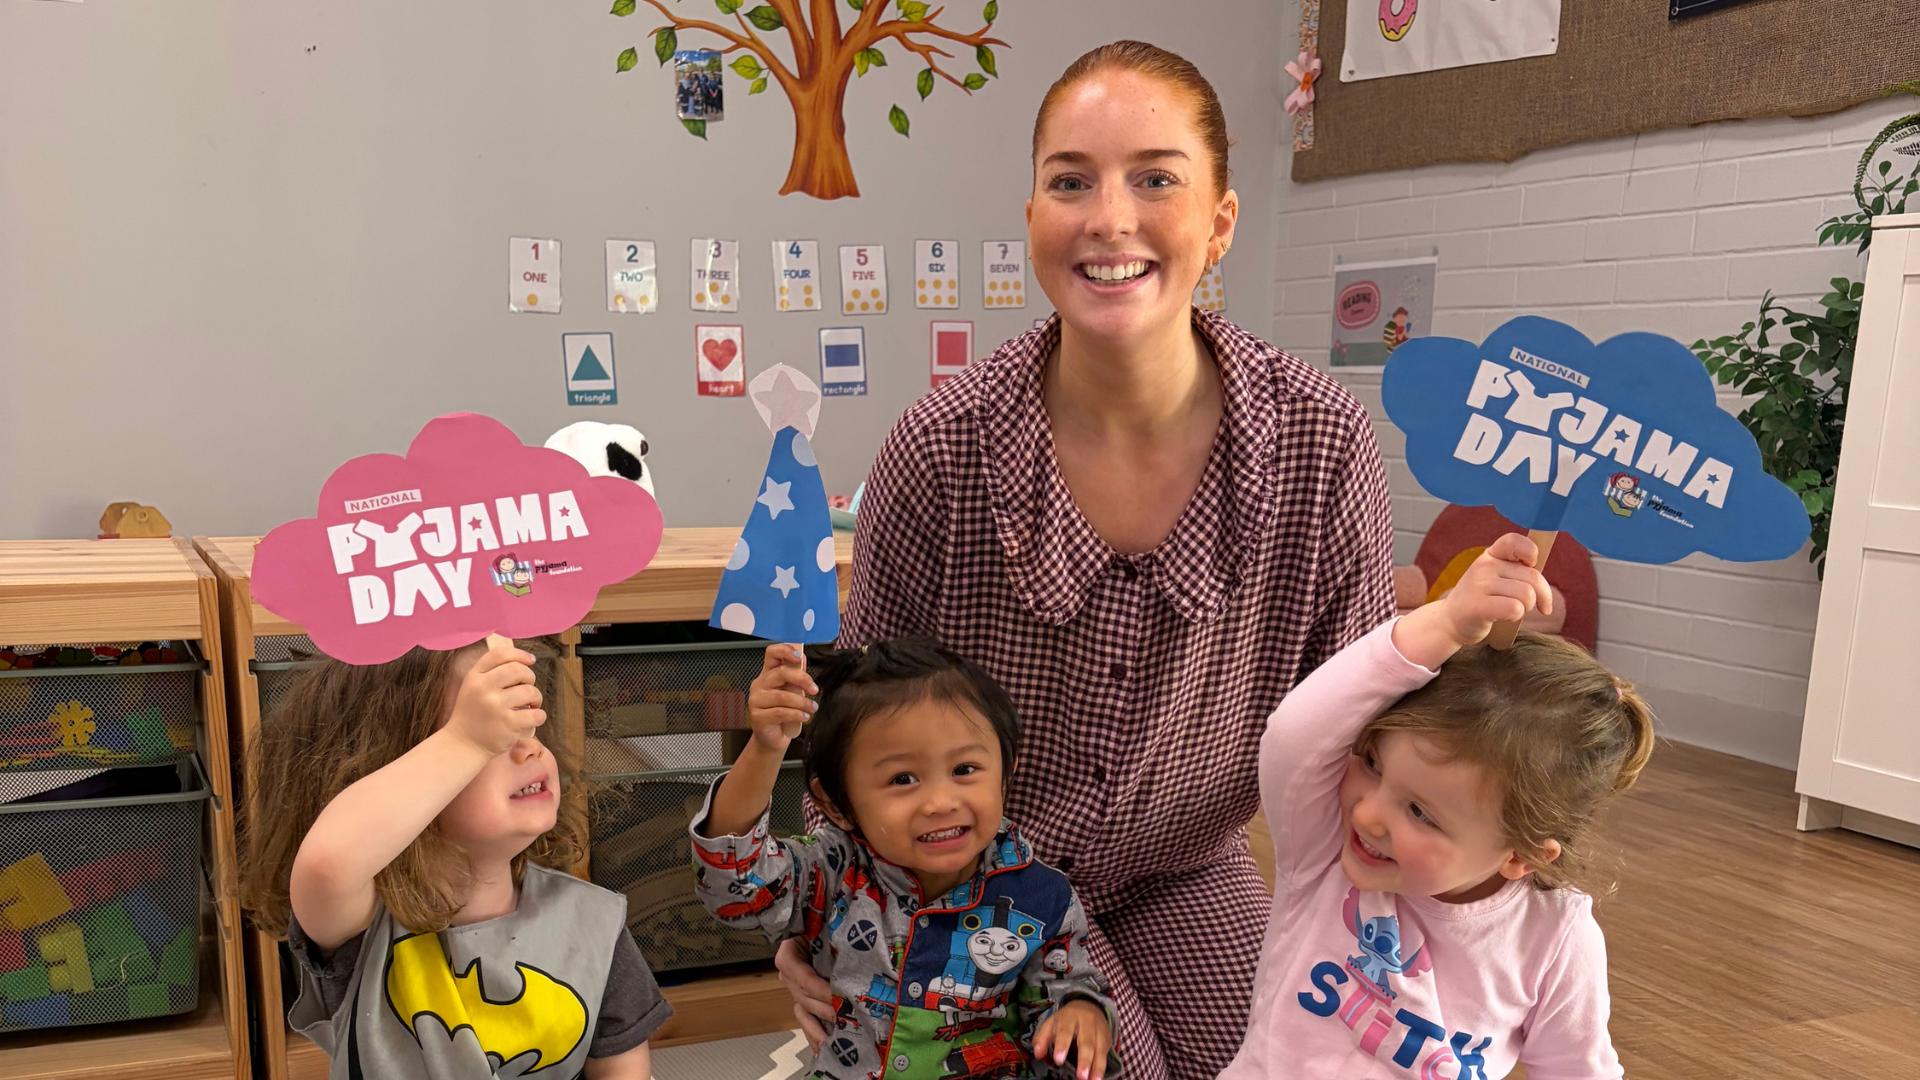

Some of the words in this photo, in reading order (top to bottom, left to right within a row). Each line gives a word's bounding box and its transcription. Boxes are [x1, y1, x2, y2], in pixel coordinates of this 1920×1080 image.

[531, 242, 540, 261] 1
[626, 244, 639, 263] 2
[711, 241, 722, 258] 3
[788, 241, 802, 259] 4
[856, 248, 868, 266] 5
[931, 241, 943, 258] 6
[997, 243, 1008, 260] 7
[696, 269, 731, 281] THREE
[783, 269, 811, 279] FOUR
[852, 271, 876, 281] FIVE
[928, 263, 945, 273] SIX
[989, 263, 1020, 273] SEVEN
[522, 271, 548, 283] ONE
[619, 272, 644, 282] TWO
[1342, 292, 1372, 310] READING
[1514, 350, 1584, 384] NATIONAL
[708, 384, 736, 394] heart
[823, 384, 865, 396] rectangle
[574, 392, 612, 404] triangle
[1466, 359, 1734, 509] PYJAMA
[1453, 412, 1597, 497] DAY
[349, 490, 417, 512] NATIONAL
[1647, 499, 1684, 517] pyjama
[326, 489, 590, 575] PYJAMA
[535, 561, 567, 574] pyjama
[348, 558, 472, 625] DAY
